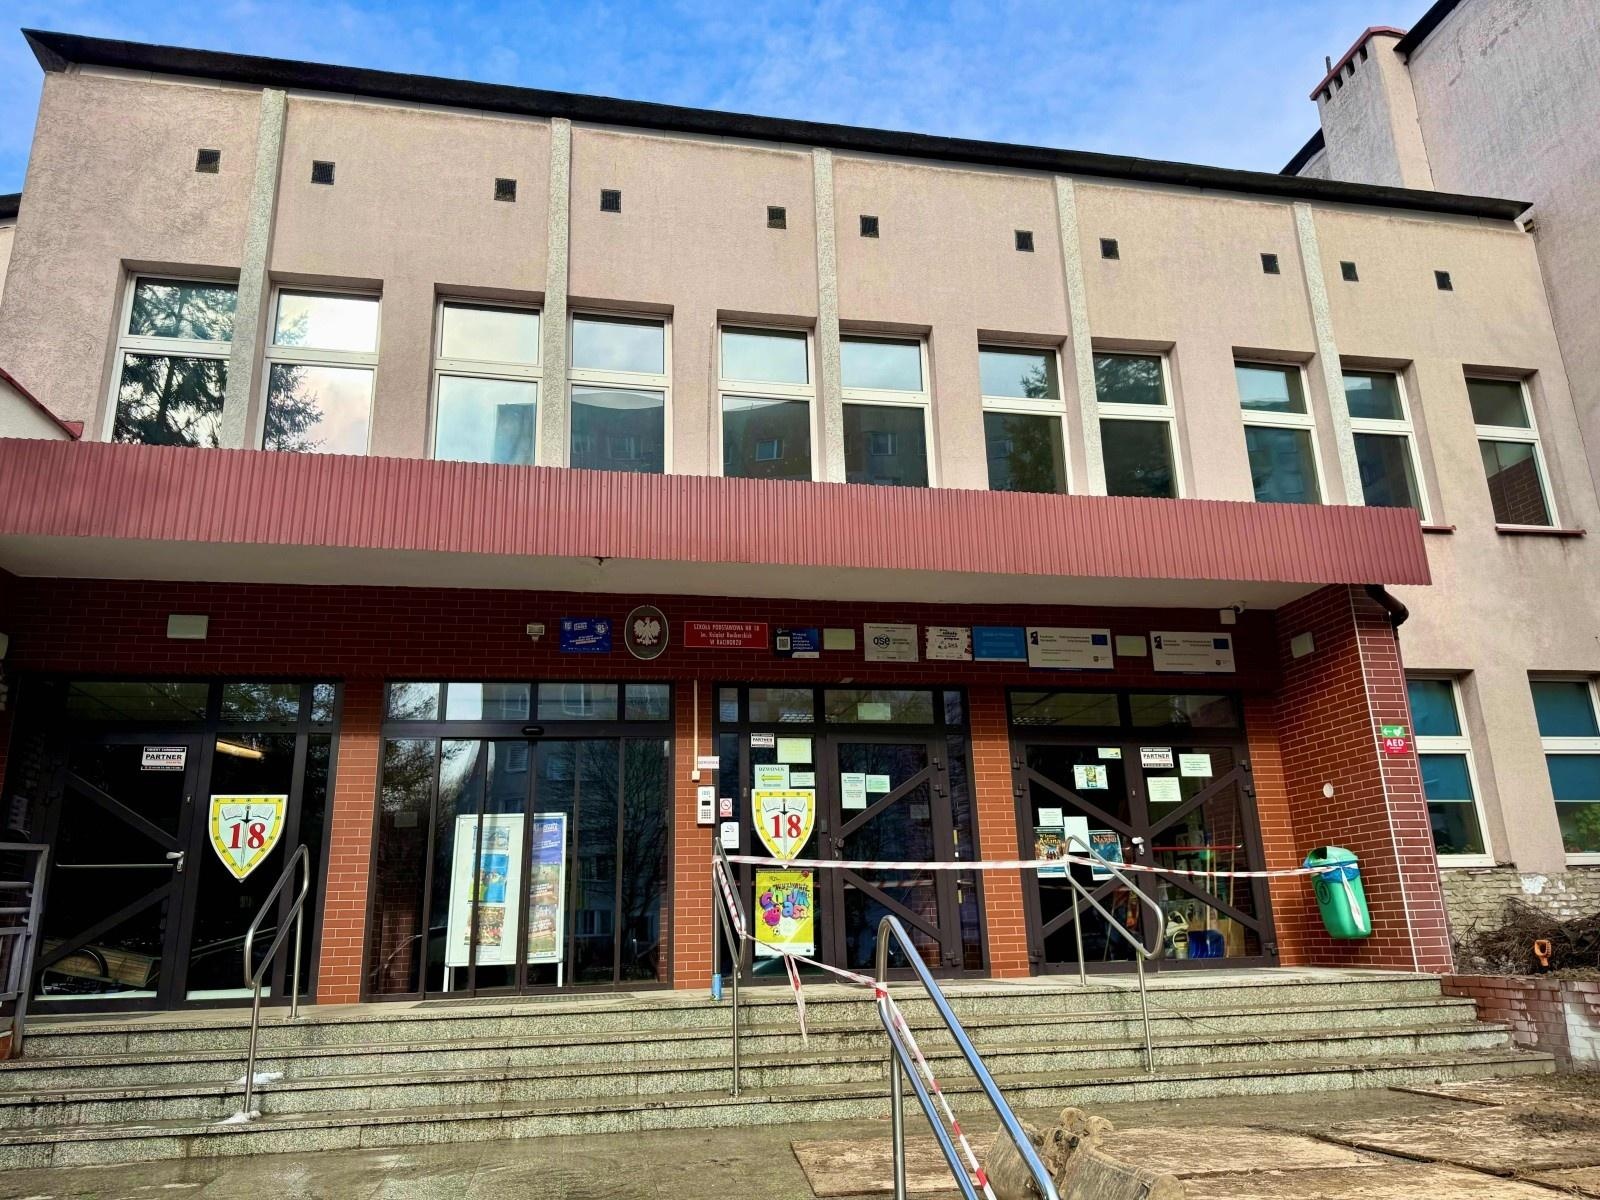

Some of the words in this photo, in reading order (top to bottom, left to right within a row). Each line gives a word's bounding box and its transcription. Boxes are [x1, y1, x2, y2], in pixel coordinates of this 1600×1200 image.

[1386, 738, 1404, 746] AED
[228, 822, 266, 849] 18
[771, 814, 802, 838] 18
